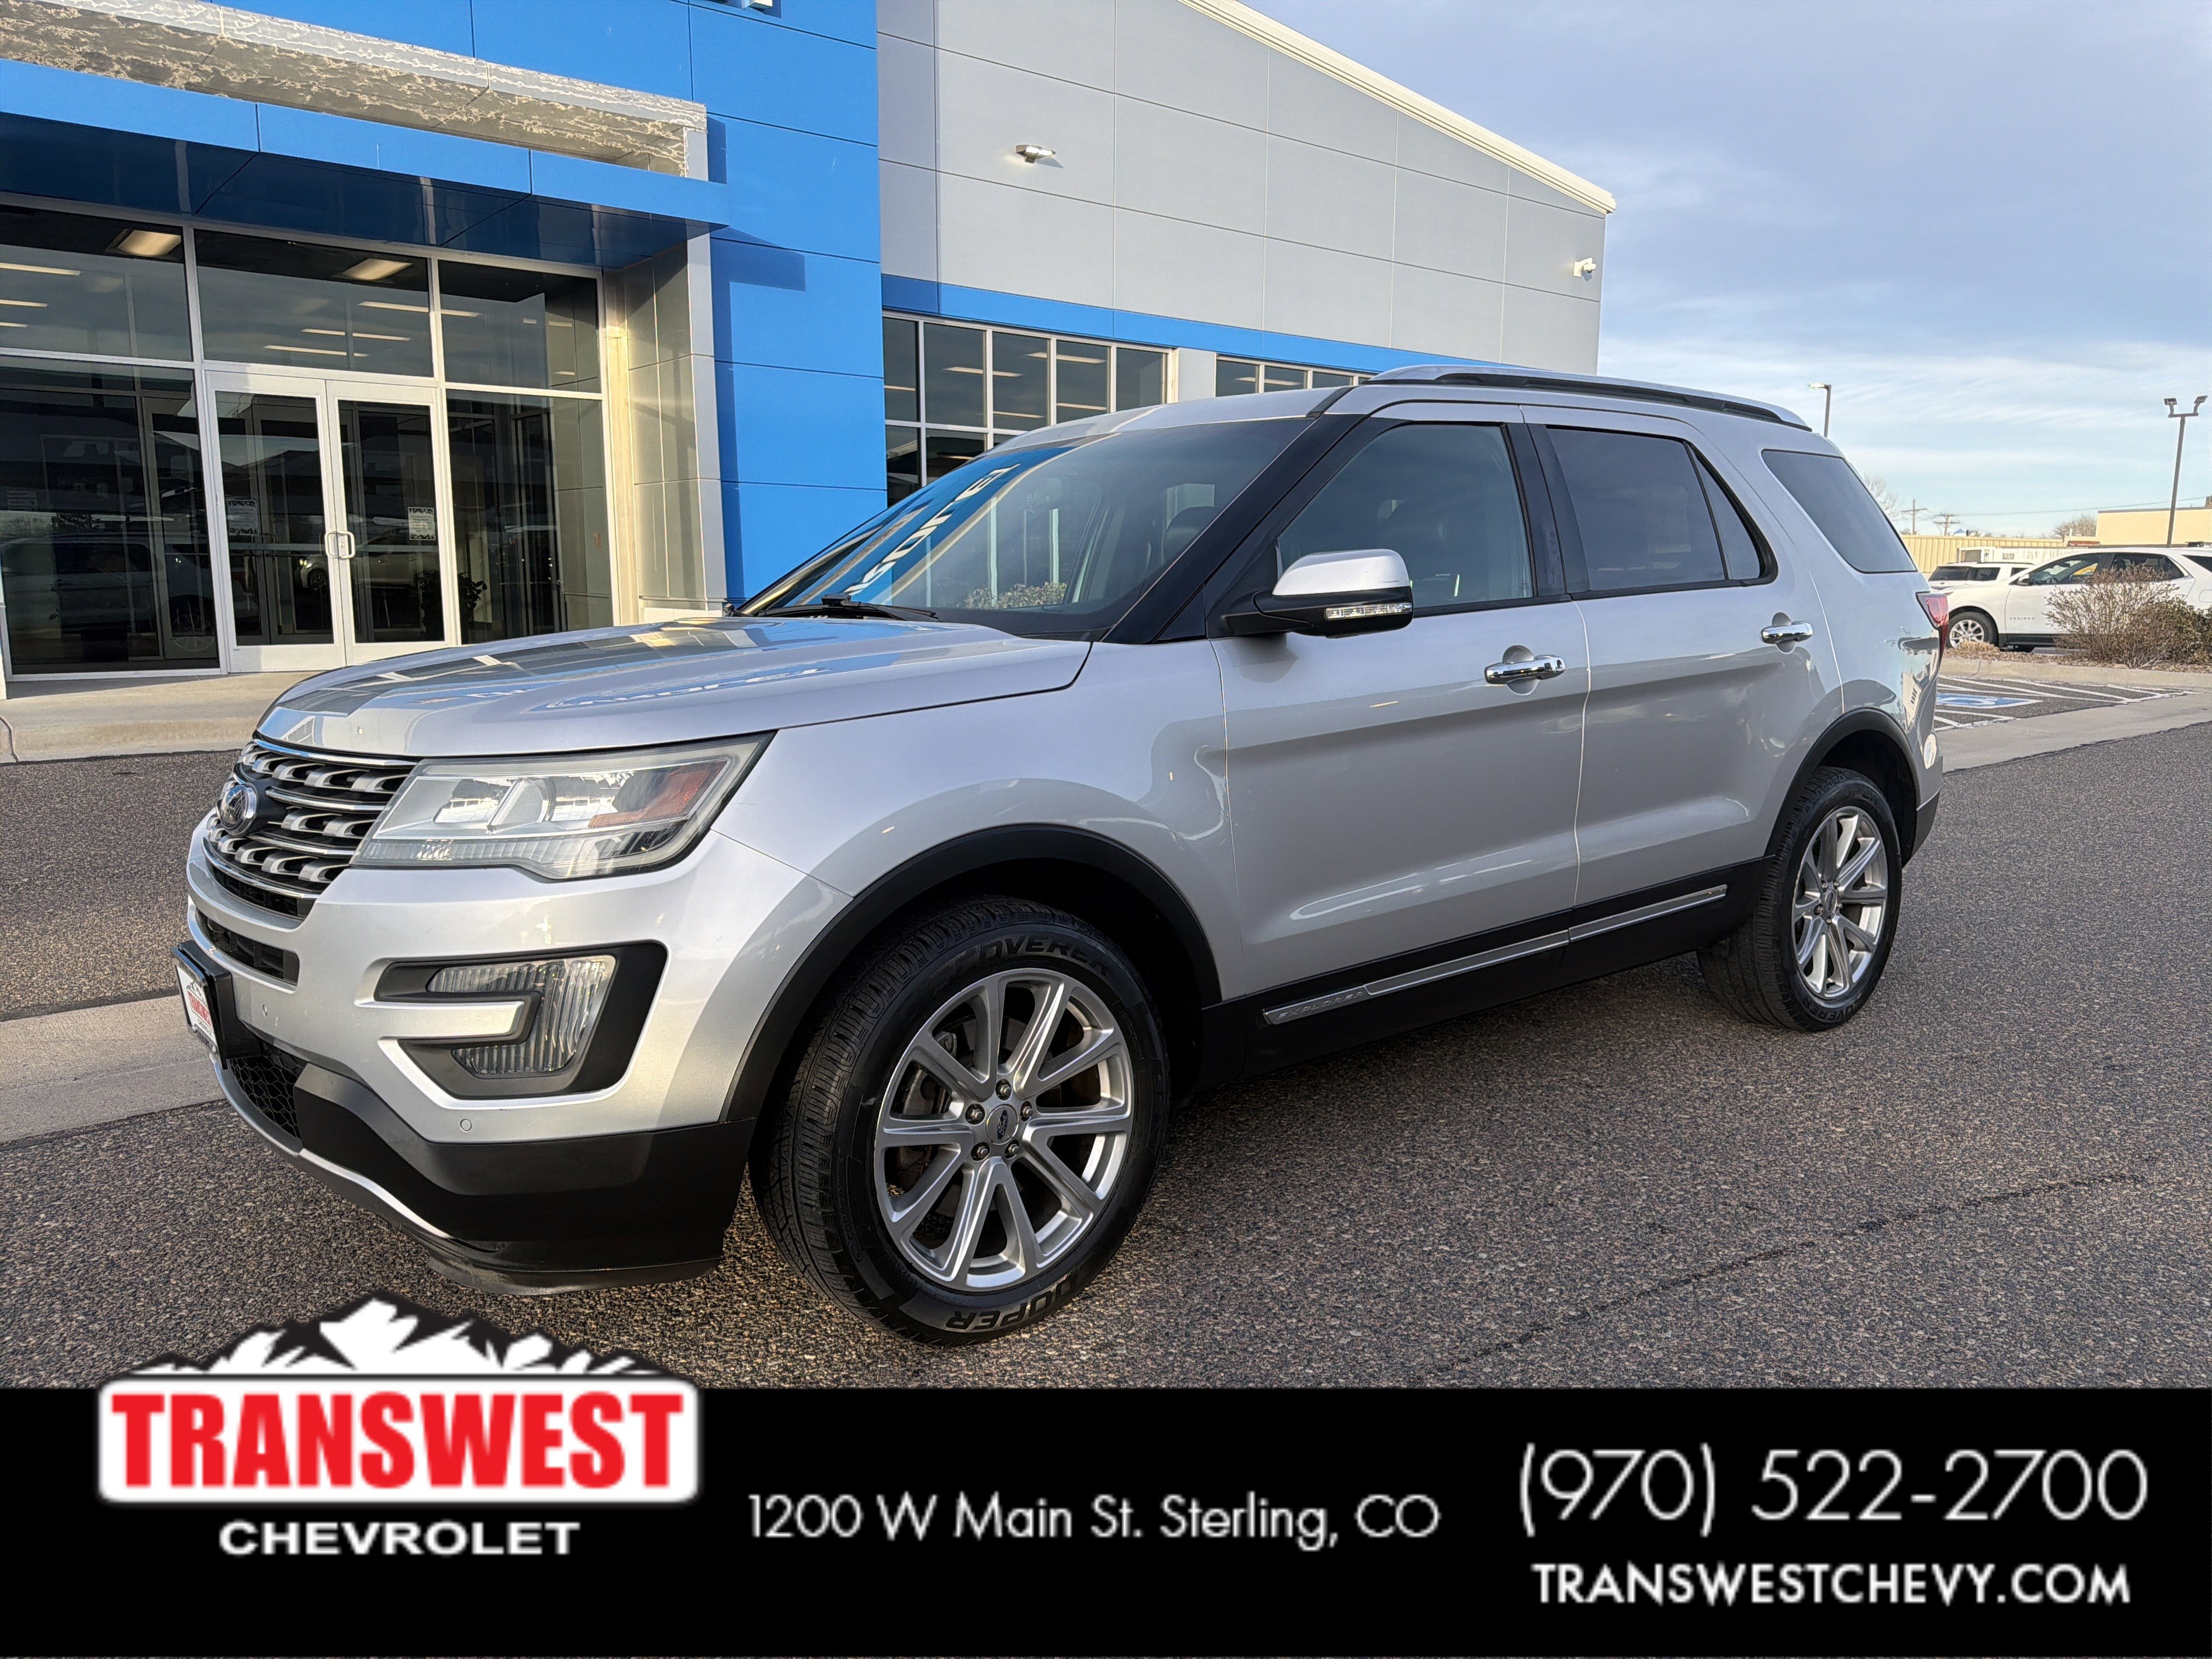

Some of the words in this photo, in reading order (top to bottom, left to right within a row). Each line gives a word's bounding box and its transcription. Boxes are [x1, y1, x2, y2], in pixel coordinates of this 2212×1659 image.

[1276, 990, 1364, 1021] EXPLORER
[998, 1114, 1008, 1136] Ford
[945, 1274, 1077, 1331] OOPER
